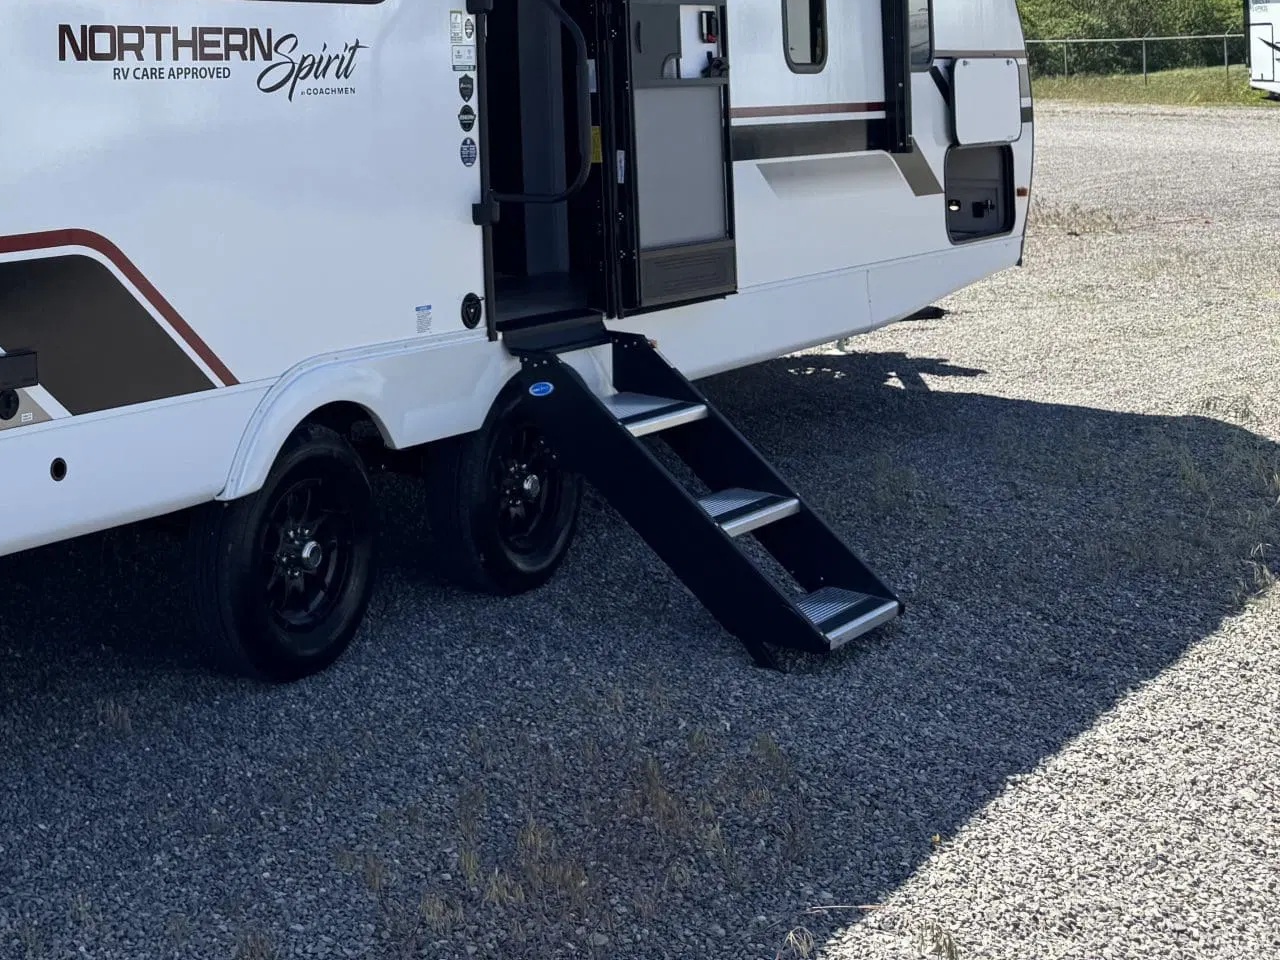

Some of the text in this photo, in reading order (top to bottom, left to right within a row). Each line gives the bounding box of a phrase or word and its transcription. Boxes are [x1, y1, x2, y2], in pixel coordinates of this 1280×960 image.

[58, 24, 370, 103] NORTHERN Spirit
[113, 66, 231, 80] RV CARE APPROVED
[306, 87, 356, 96] COACHMEN
